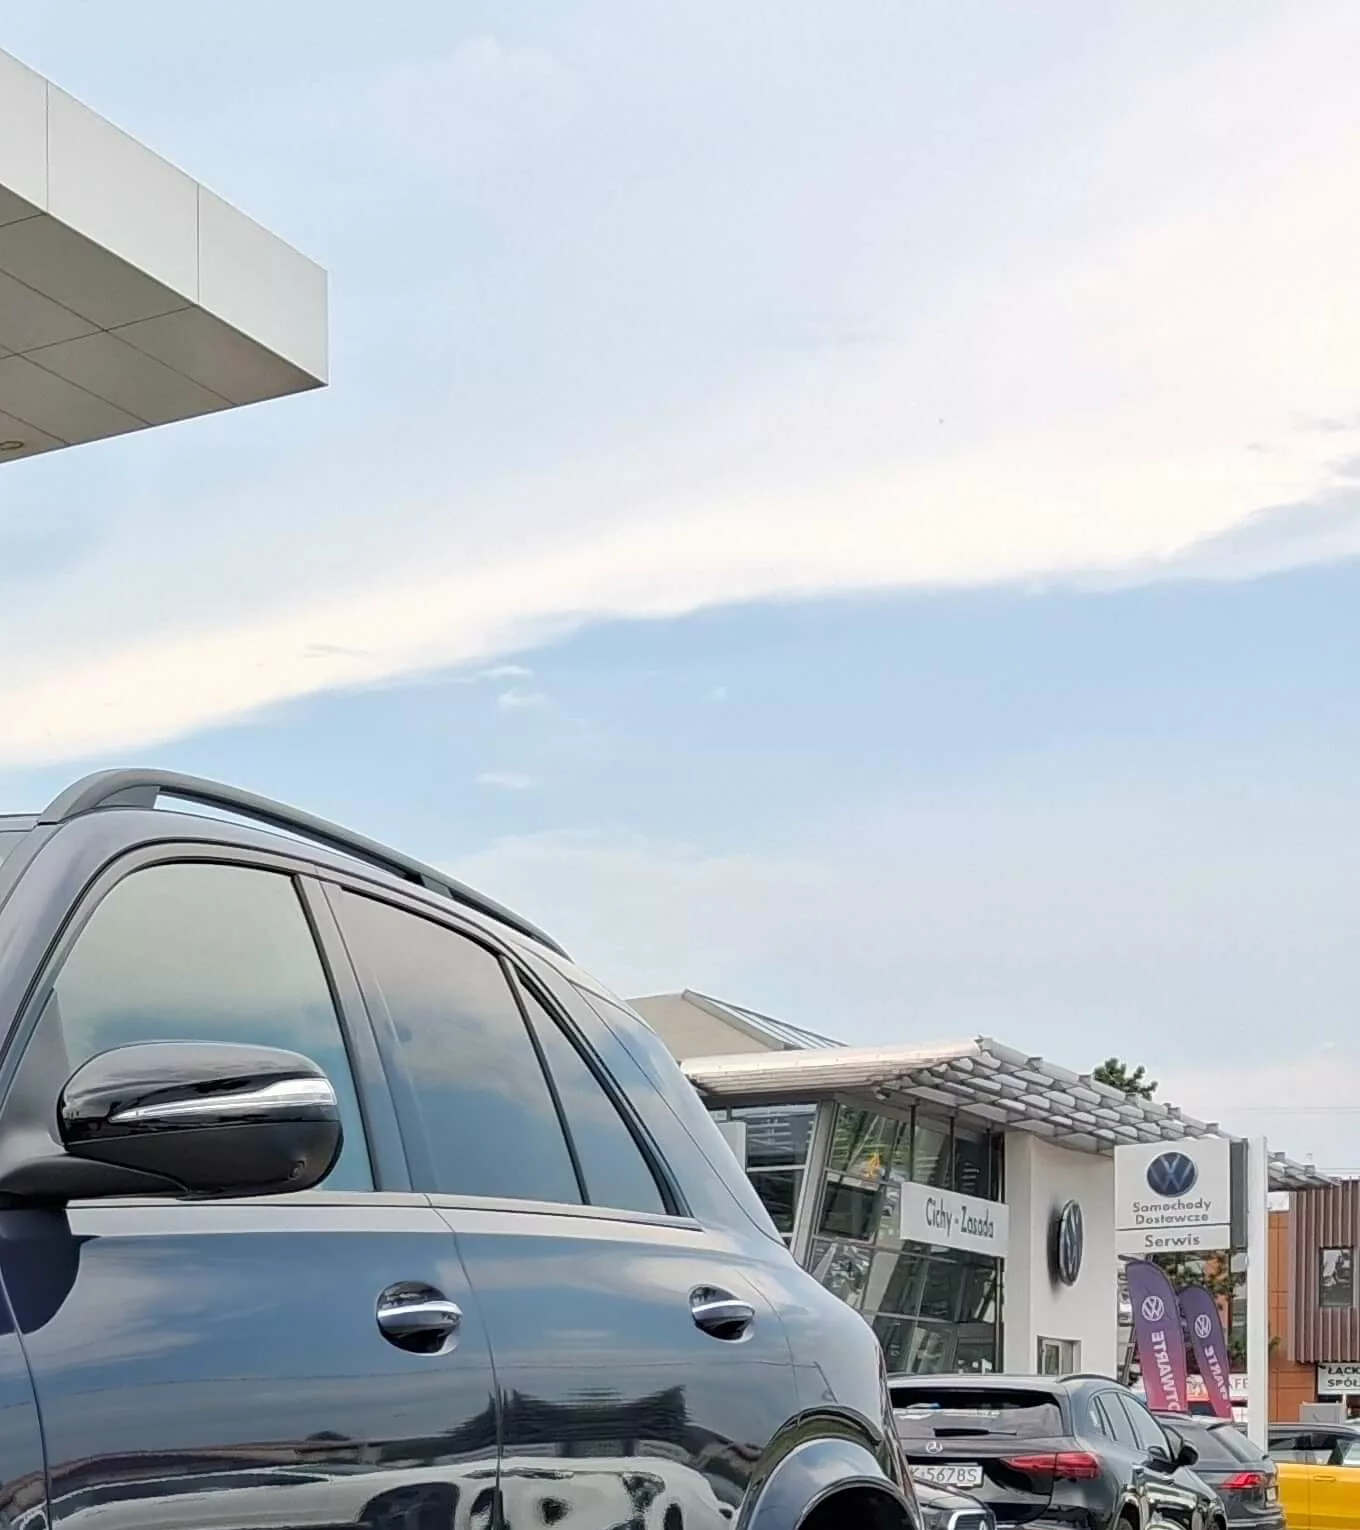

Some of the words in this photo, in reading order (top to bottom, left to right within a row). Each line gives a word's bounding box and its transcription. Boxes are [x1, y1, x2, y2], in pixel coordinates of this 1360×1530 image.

[1133, 1198, 1212, 1213] Samochody
[1135, 1213, 1209, 1225] Dostawcze
[1144, 1233, 1201, 1248] Serwis
[927, 1467, 977, 1482] 5678S
